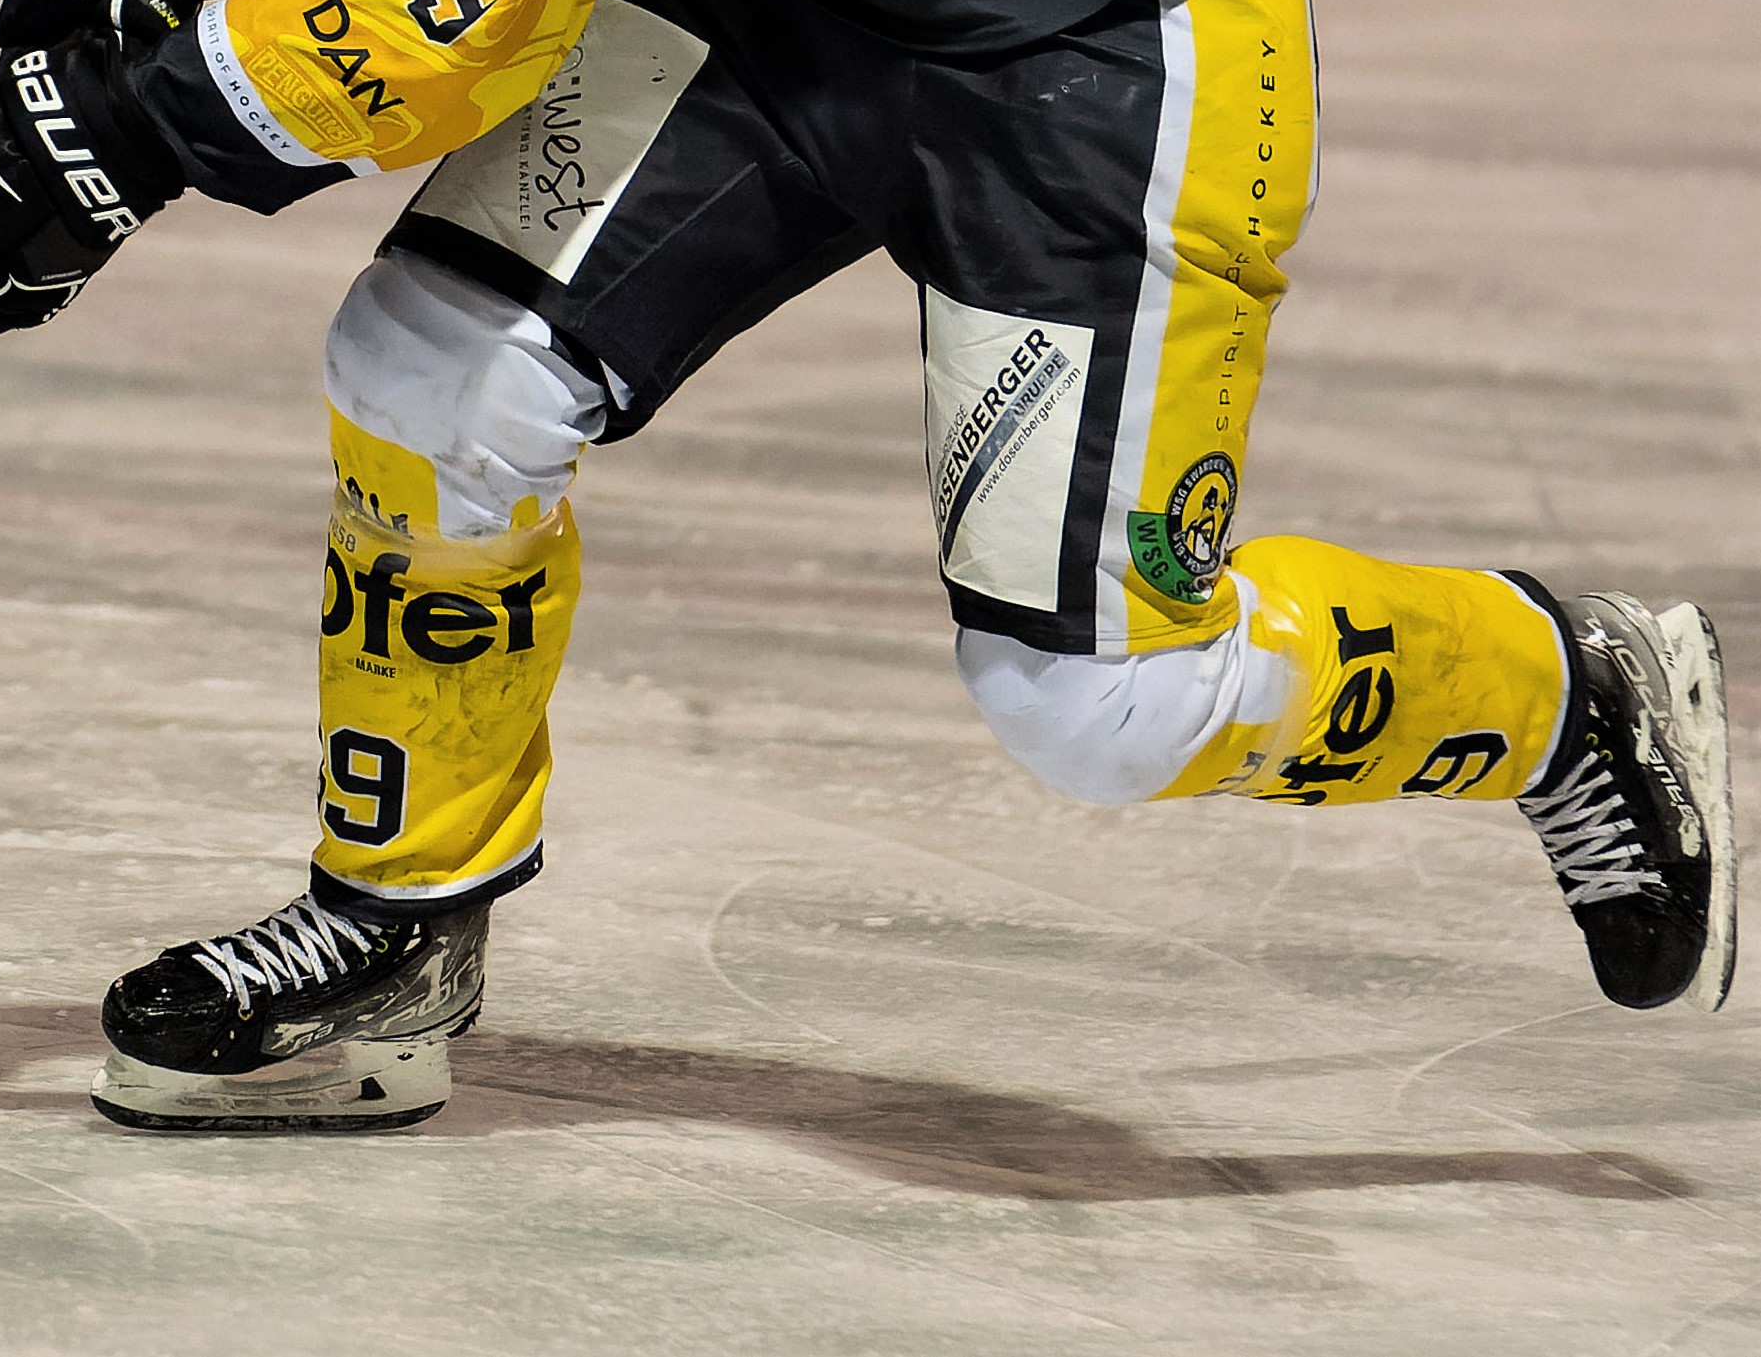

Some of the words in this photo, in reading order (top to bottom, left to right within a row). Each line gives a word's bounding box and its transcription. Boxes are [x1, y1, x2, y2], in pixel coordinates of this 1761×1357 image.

[10, 49, 142, 243] BAUER
[215, 52, 231, 75] OF
[228, 79, 291, 151] HOCKEY
[1215, 304, 1248, 432] SPIRIT
[1248, 39, 1279, 237] HOCKEY
[1136, 518, 1170, 581] WSG
